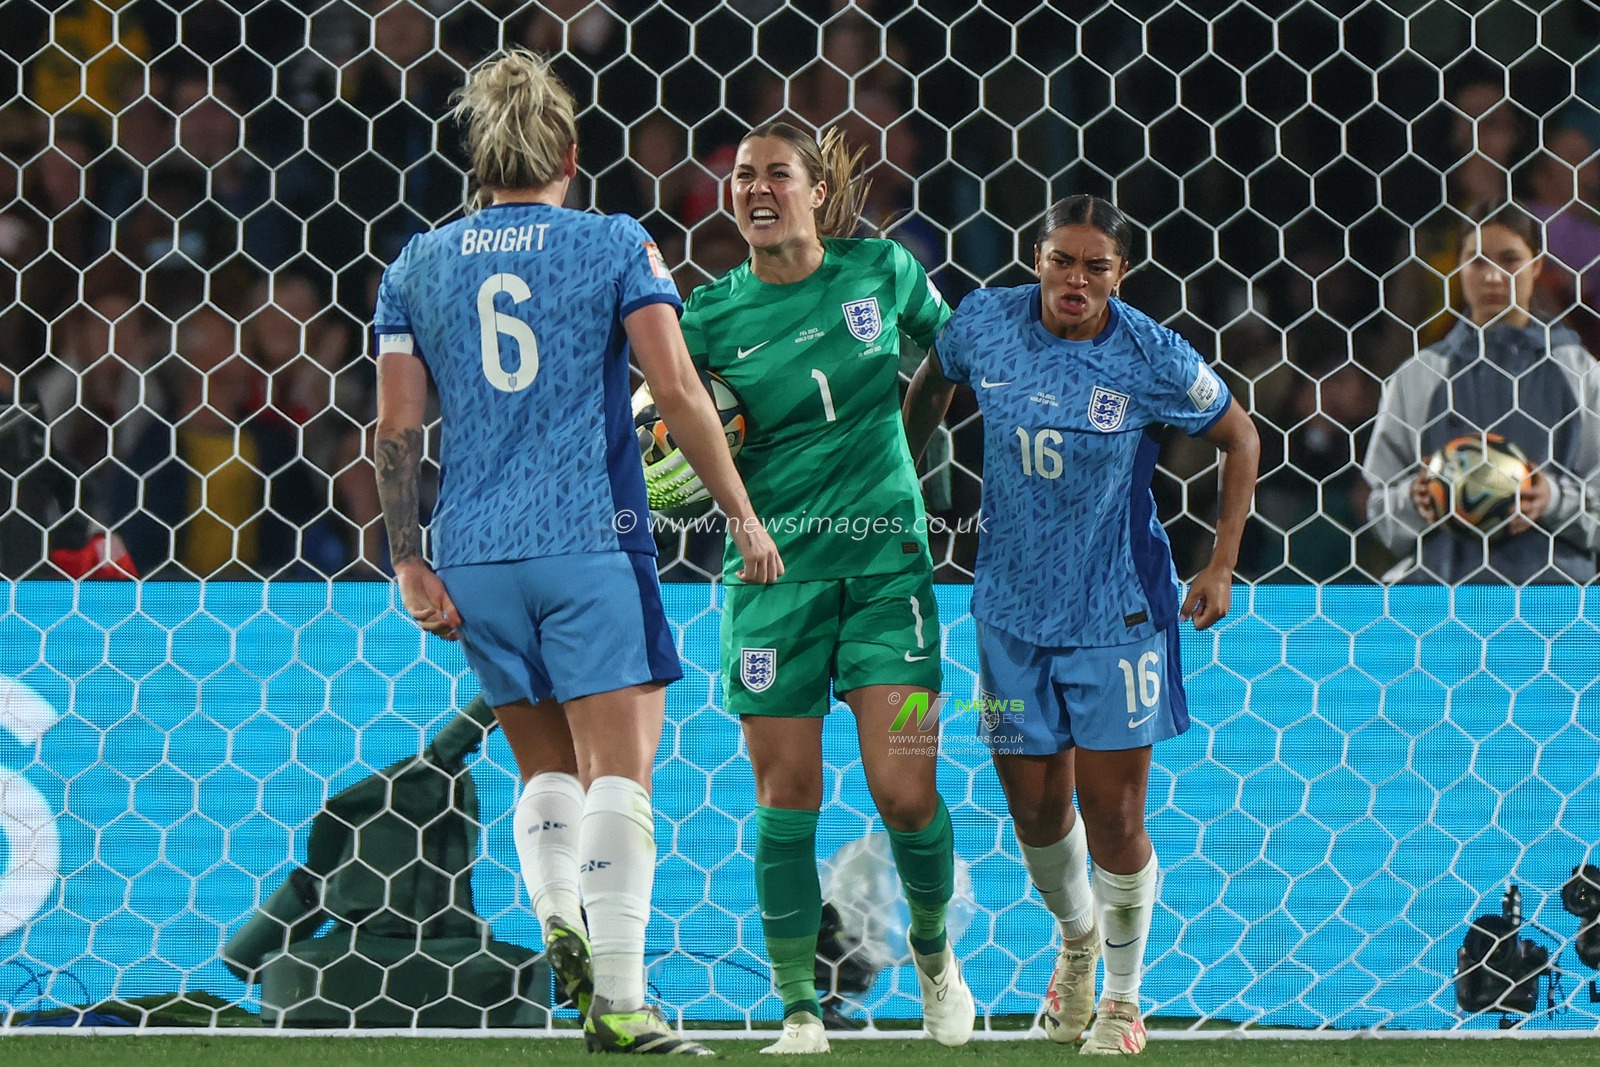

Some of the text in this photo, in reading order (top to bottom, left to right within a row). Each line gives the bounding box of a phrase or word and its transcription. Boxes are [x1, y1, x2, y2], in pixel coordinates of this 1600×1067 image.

[461, 223, 550, 256] BRIGHT
[476, 273, 540, 393] 6
[811, 368, 837, 422] 1
[1015, 425, 1064, 480] 16
[909, 595, 925, 649] 1
[1117, 651, 1161, 714] 16
